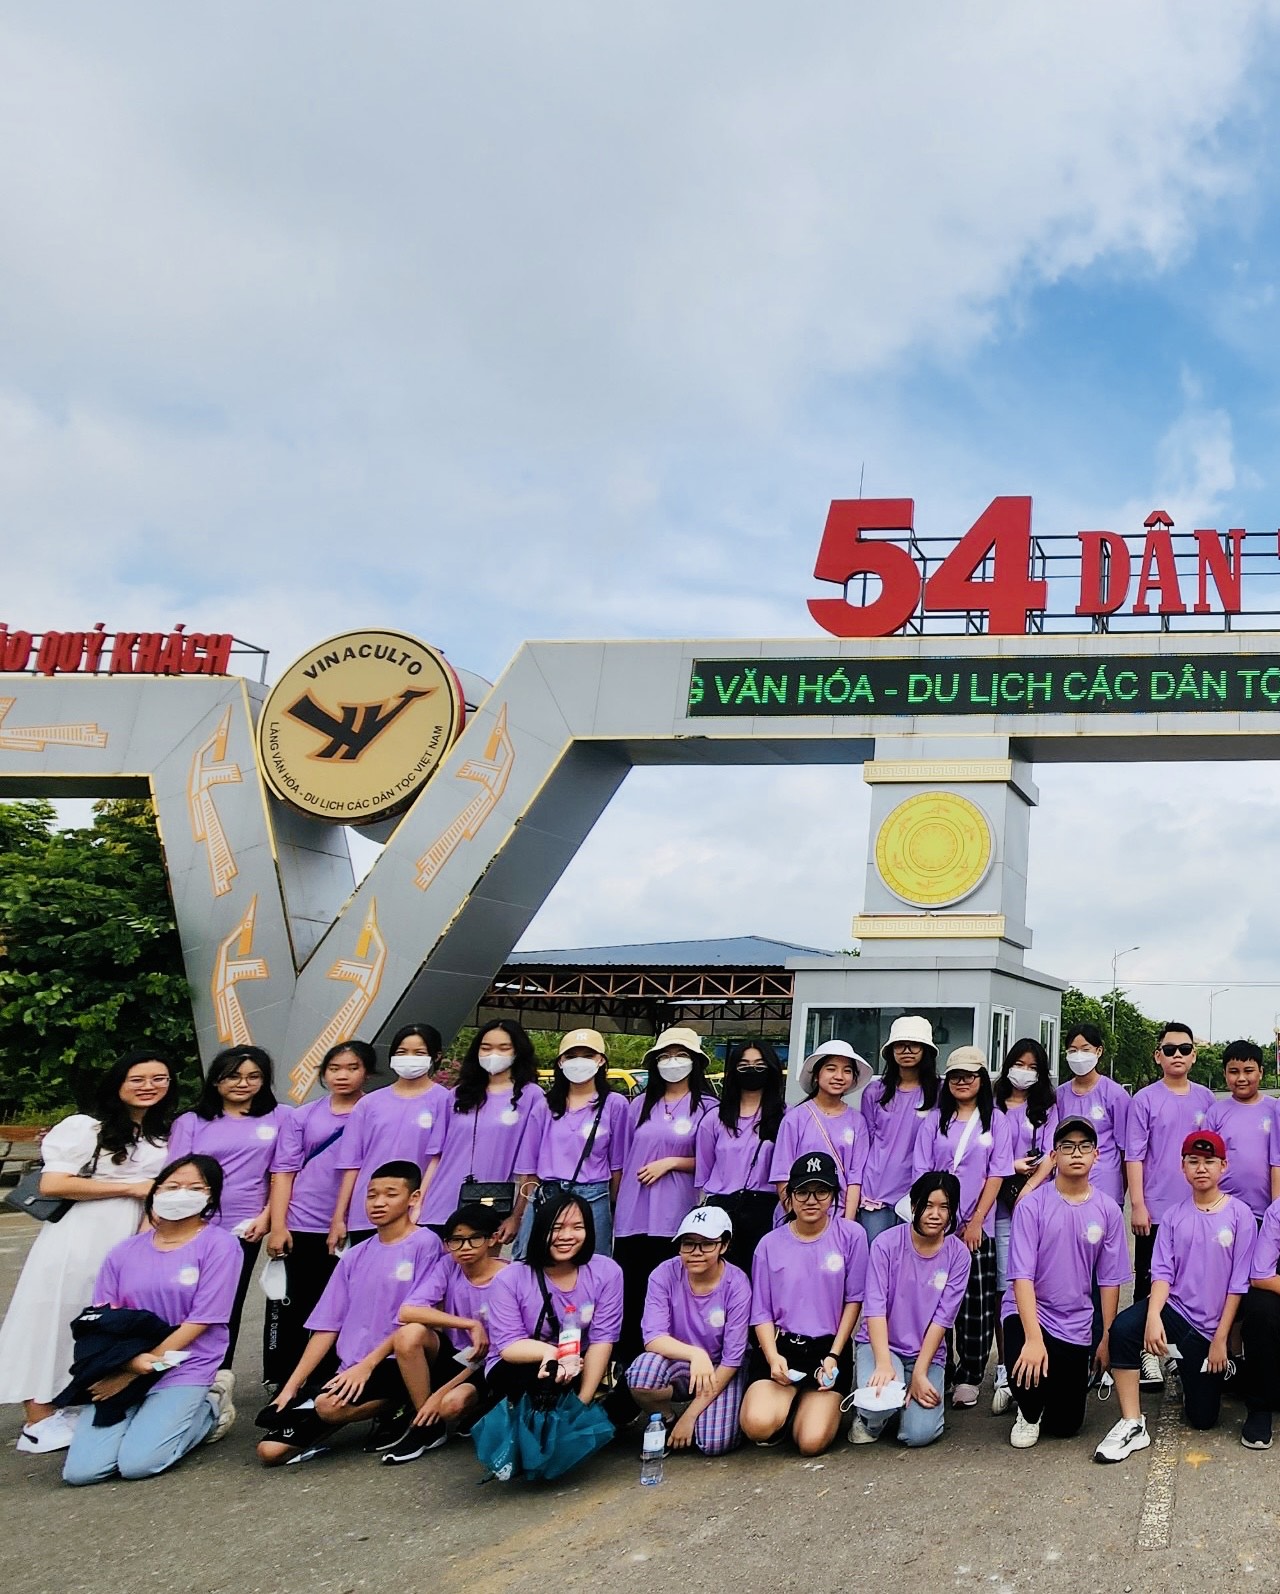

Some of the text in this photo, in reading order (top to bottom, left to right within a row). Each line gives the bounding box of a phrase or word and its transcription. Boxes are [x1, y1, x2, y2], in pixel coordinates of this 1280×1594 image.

[807, 496, 1048, 638] 54
[1075, 510, 1247, 616] DÂN
[36, 623, 106, 676] QUÝ
[110, 624, 234, 674] KHÁCH
[302, 644, 423, 679] VINACULTO
[714, 667, 788, 704] VĂN
[797, 667, 875, 704] HÓA
[907, 673, 960, 702] DU
[970, 672, 1053, 707] LỊCH
[1063, 664, 1139, 700] CÁC
[1150, 663, 1227, 700] DÂN
[303, 792, 320, 805] DU
[428, 725, 443, 750] NAM
